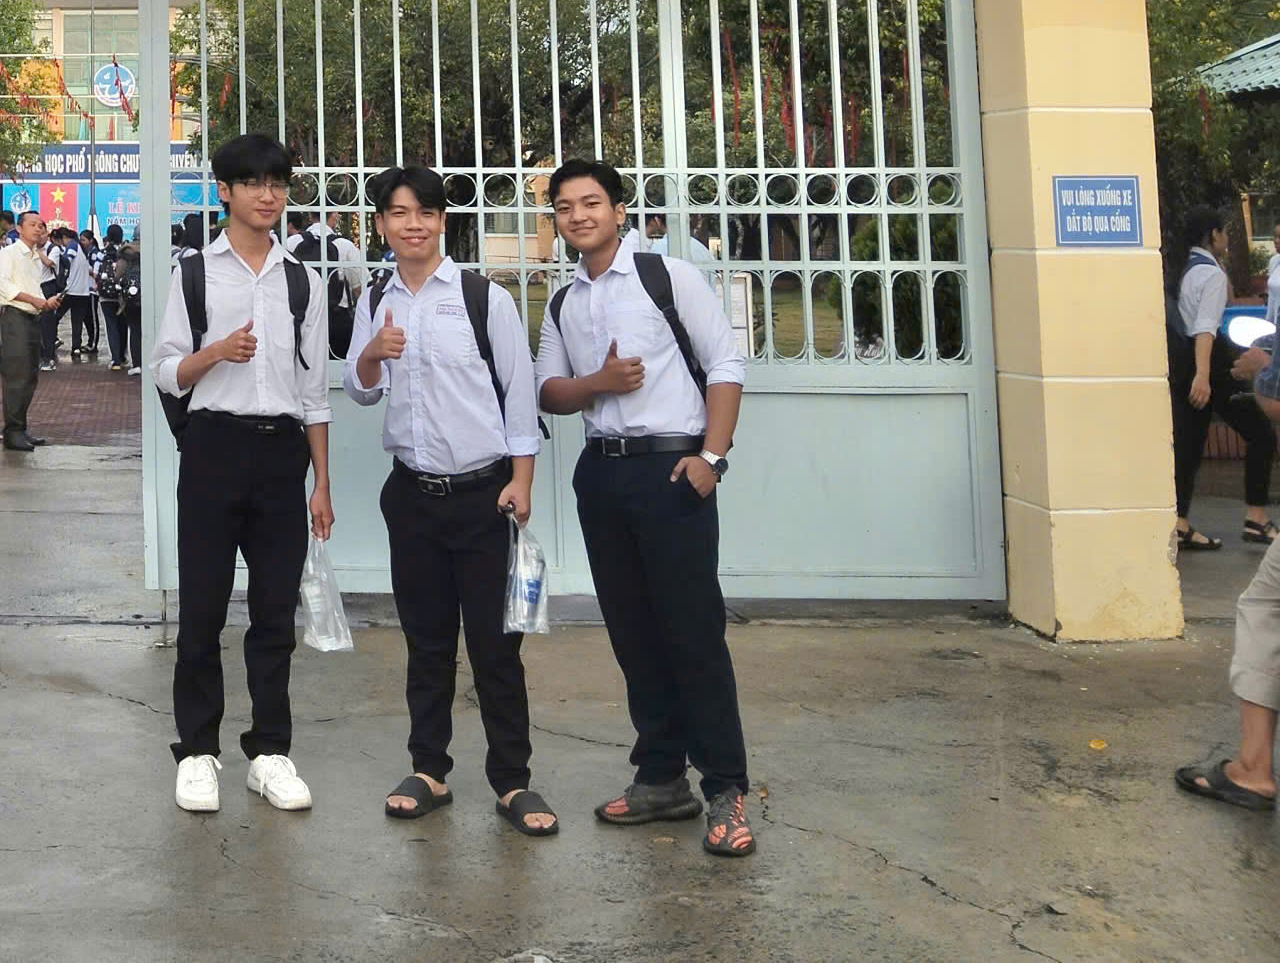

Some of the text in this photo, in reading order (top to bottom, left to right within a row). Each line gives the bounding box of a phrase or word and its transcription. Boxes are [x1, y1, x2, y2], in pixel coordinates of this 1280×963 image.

[120, 154, 140, 172] CHU
[1062, 184, 1132, 206] VUI LÒNG XUỐNG XE
[1082, 212, 1092, 235] BỘ
[1094, 216, 1109, 233] QUA
[1111, 209, 1130, 232] CỔNG
